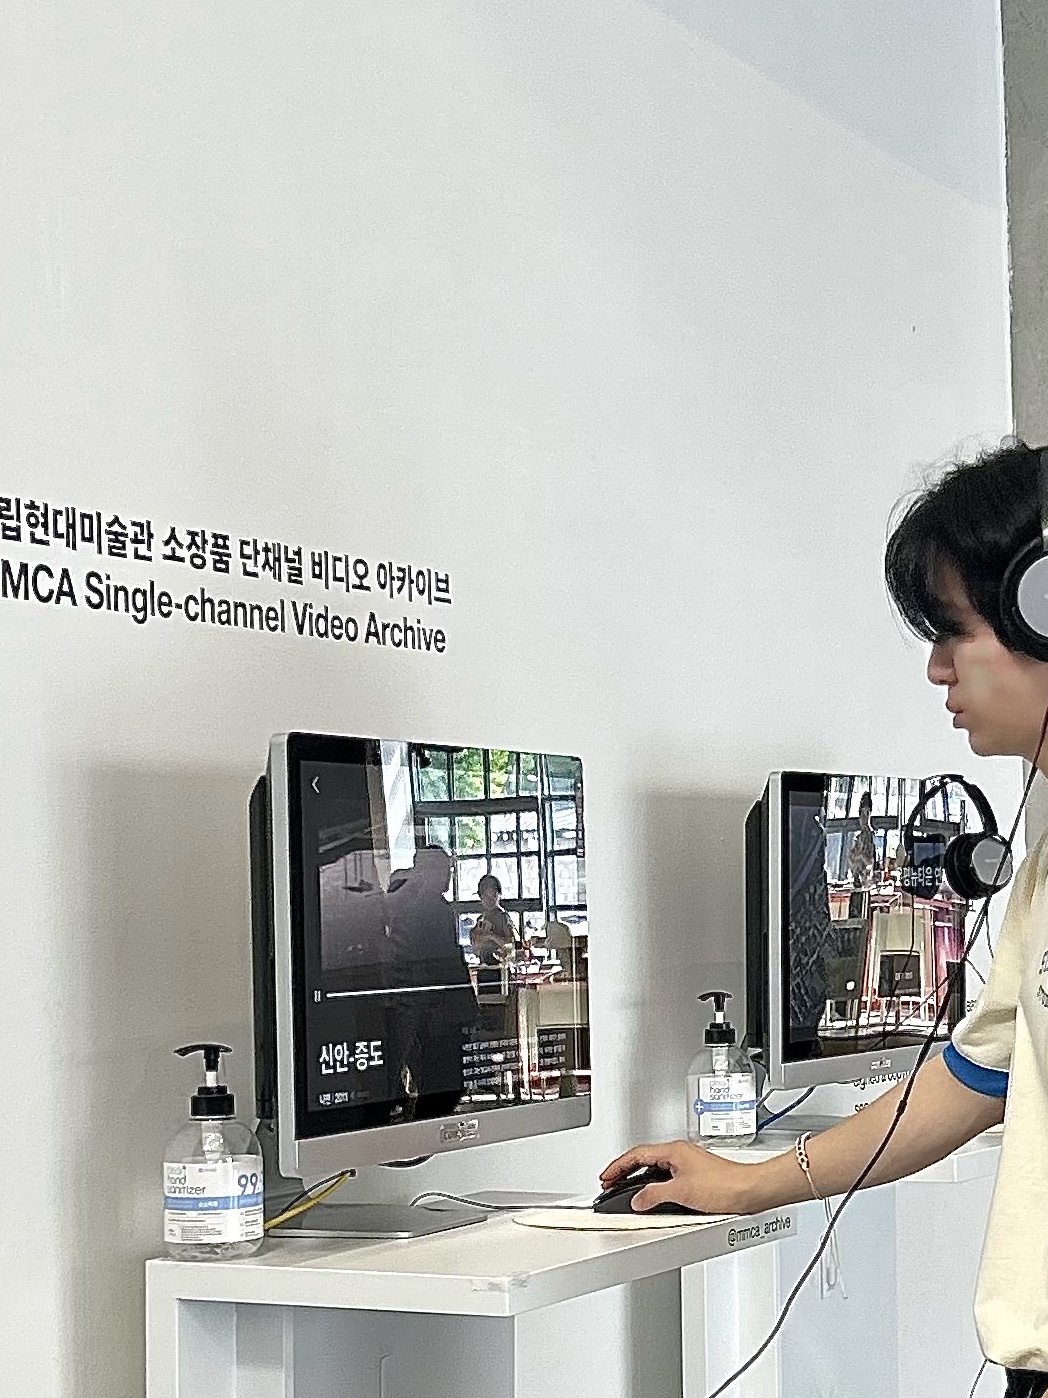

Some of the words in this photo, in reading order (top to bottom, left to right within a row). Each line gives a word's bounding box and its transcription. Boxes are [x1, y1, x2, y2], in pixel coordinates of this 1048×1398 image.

[0, 496, 154, 562] 립현대미술관
[162, 526, 232, 574] 소장품
[239, 538, 303, 586] 단채널
[310, 550, 372, 593] 비디오
[376, 561, 452, 606] 아카이브
[0, 558, 78, 607] MCA
[84, 570, 286, 633] Single-channel
[290, 599, 360, 643] Video
[363, 611, 447, 653] Archive
